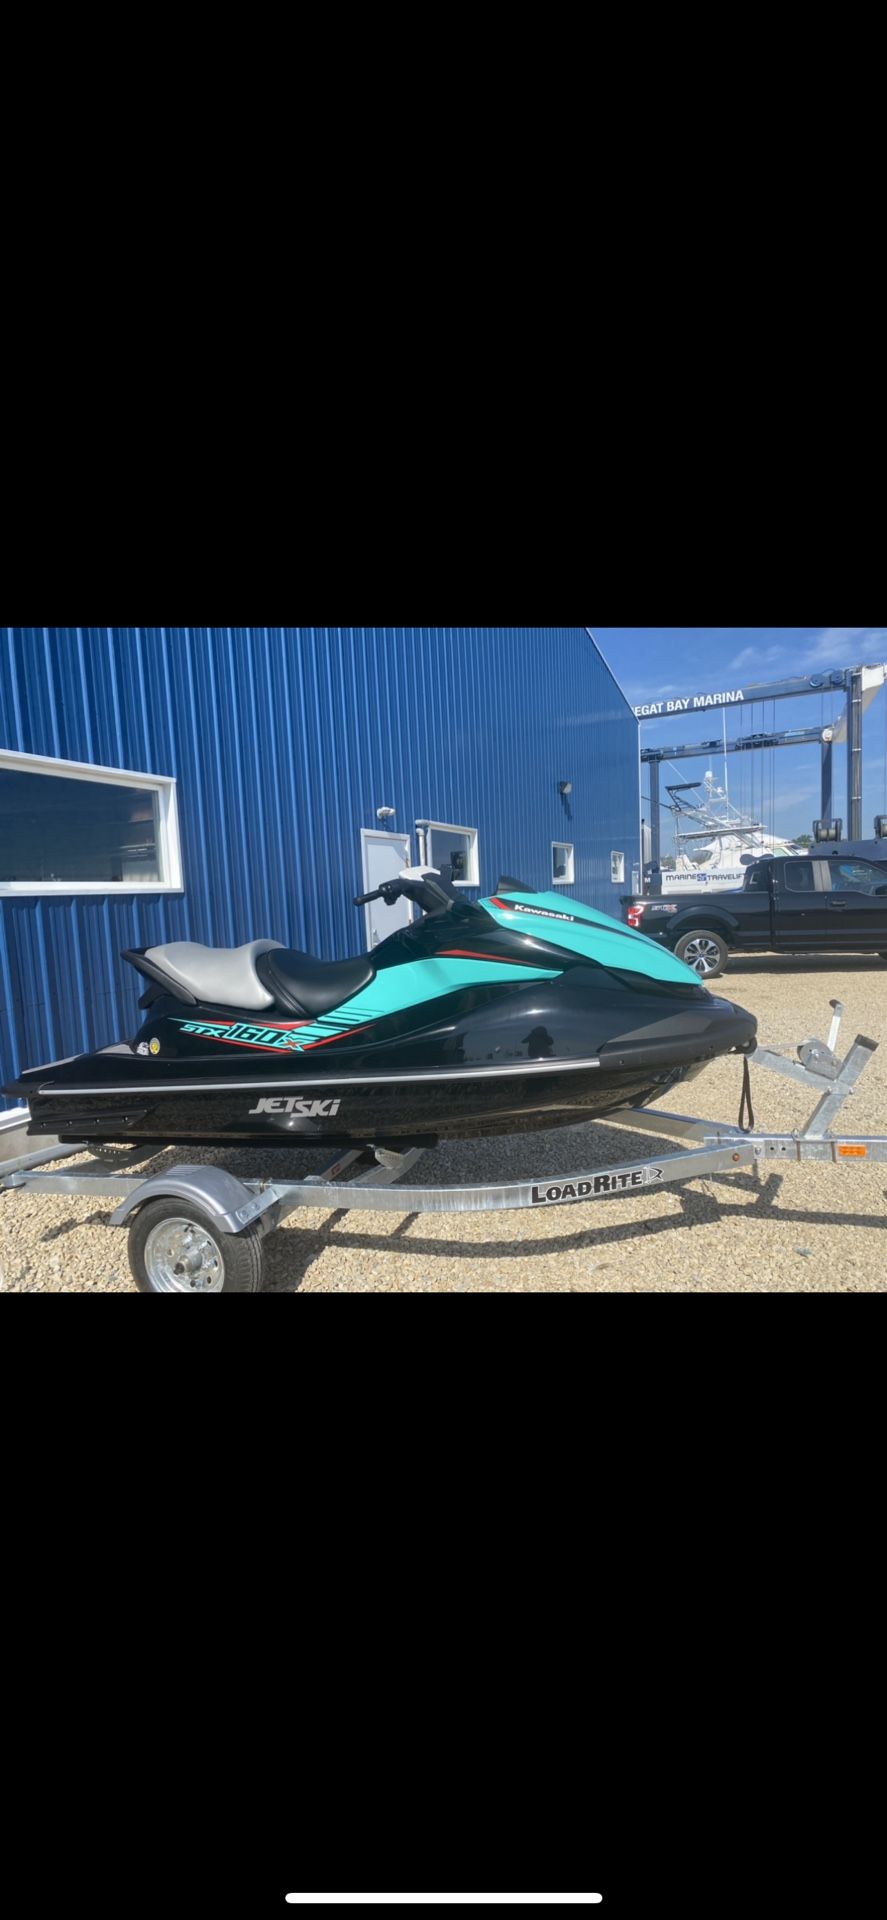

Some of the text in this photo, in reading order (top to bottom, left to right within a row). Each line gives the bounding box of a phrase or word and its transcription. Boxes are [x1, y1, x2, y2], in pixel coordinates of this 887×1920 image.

[667, 698, 690, 712] BAY
[693, 689, 745, 708] MARINA
[665, 873, 697, 881] MARINE
[514, 904, 574, 921] Kawasaki
